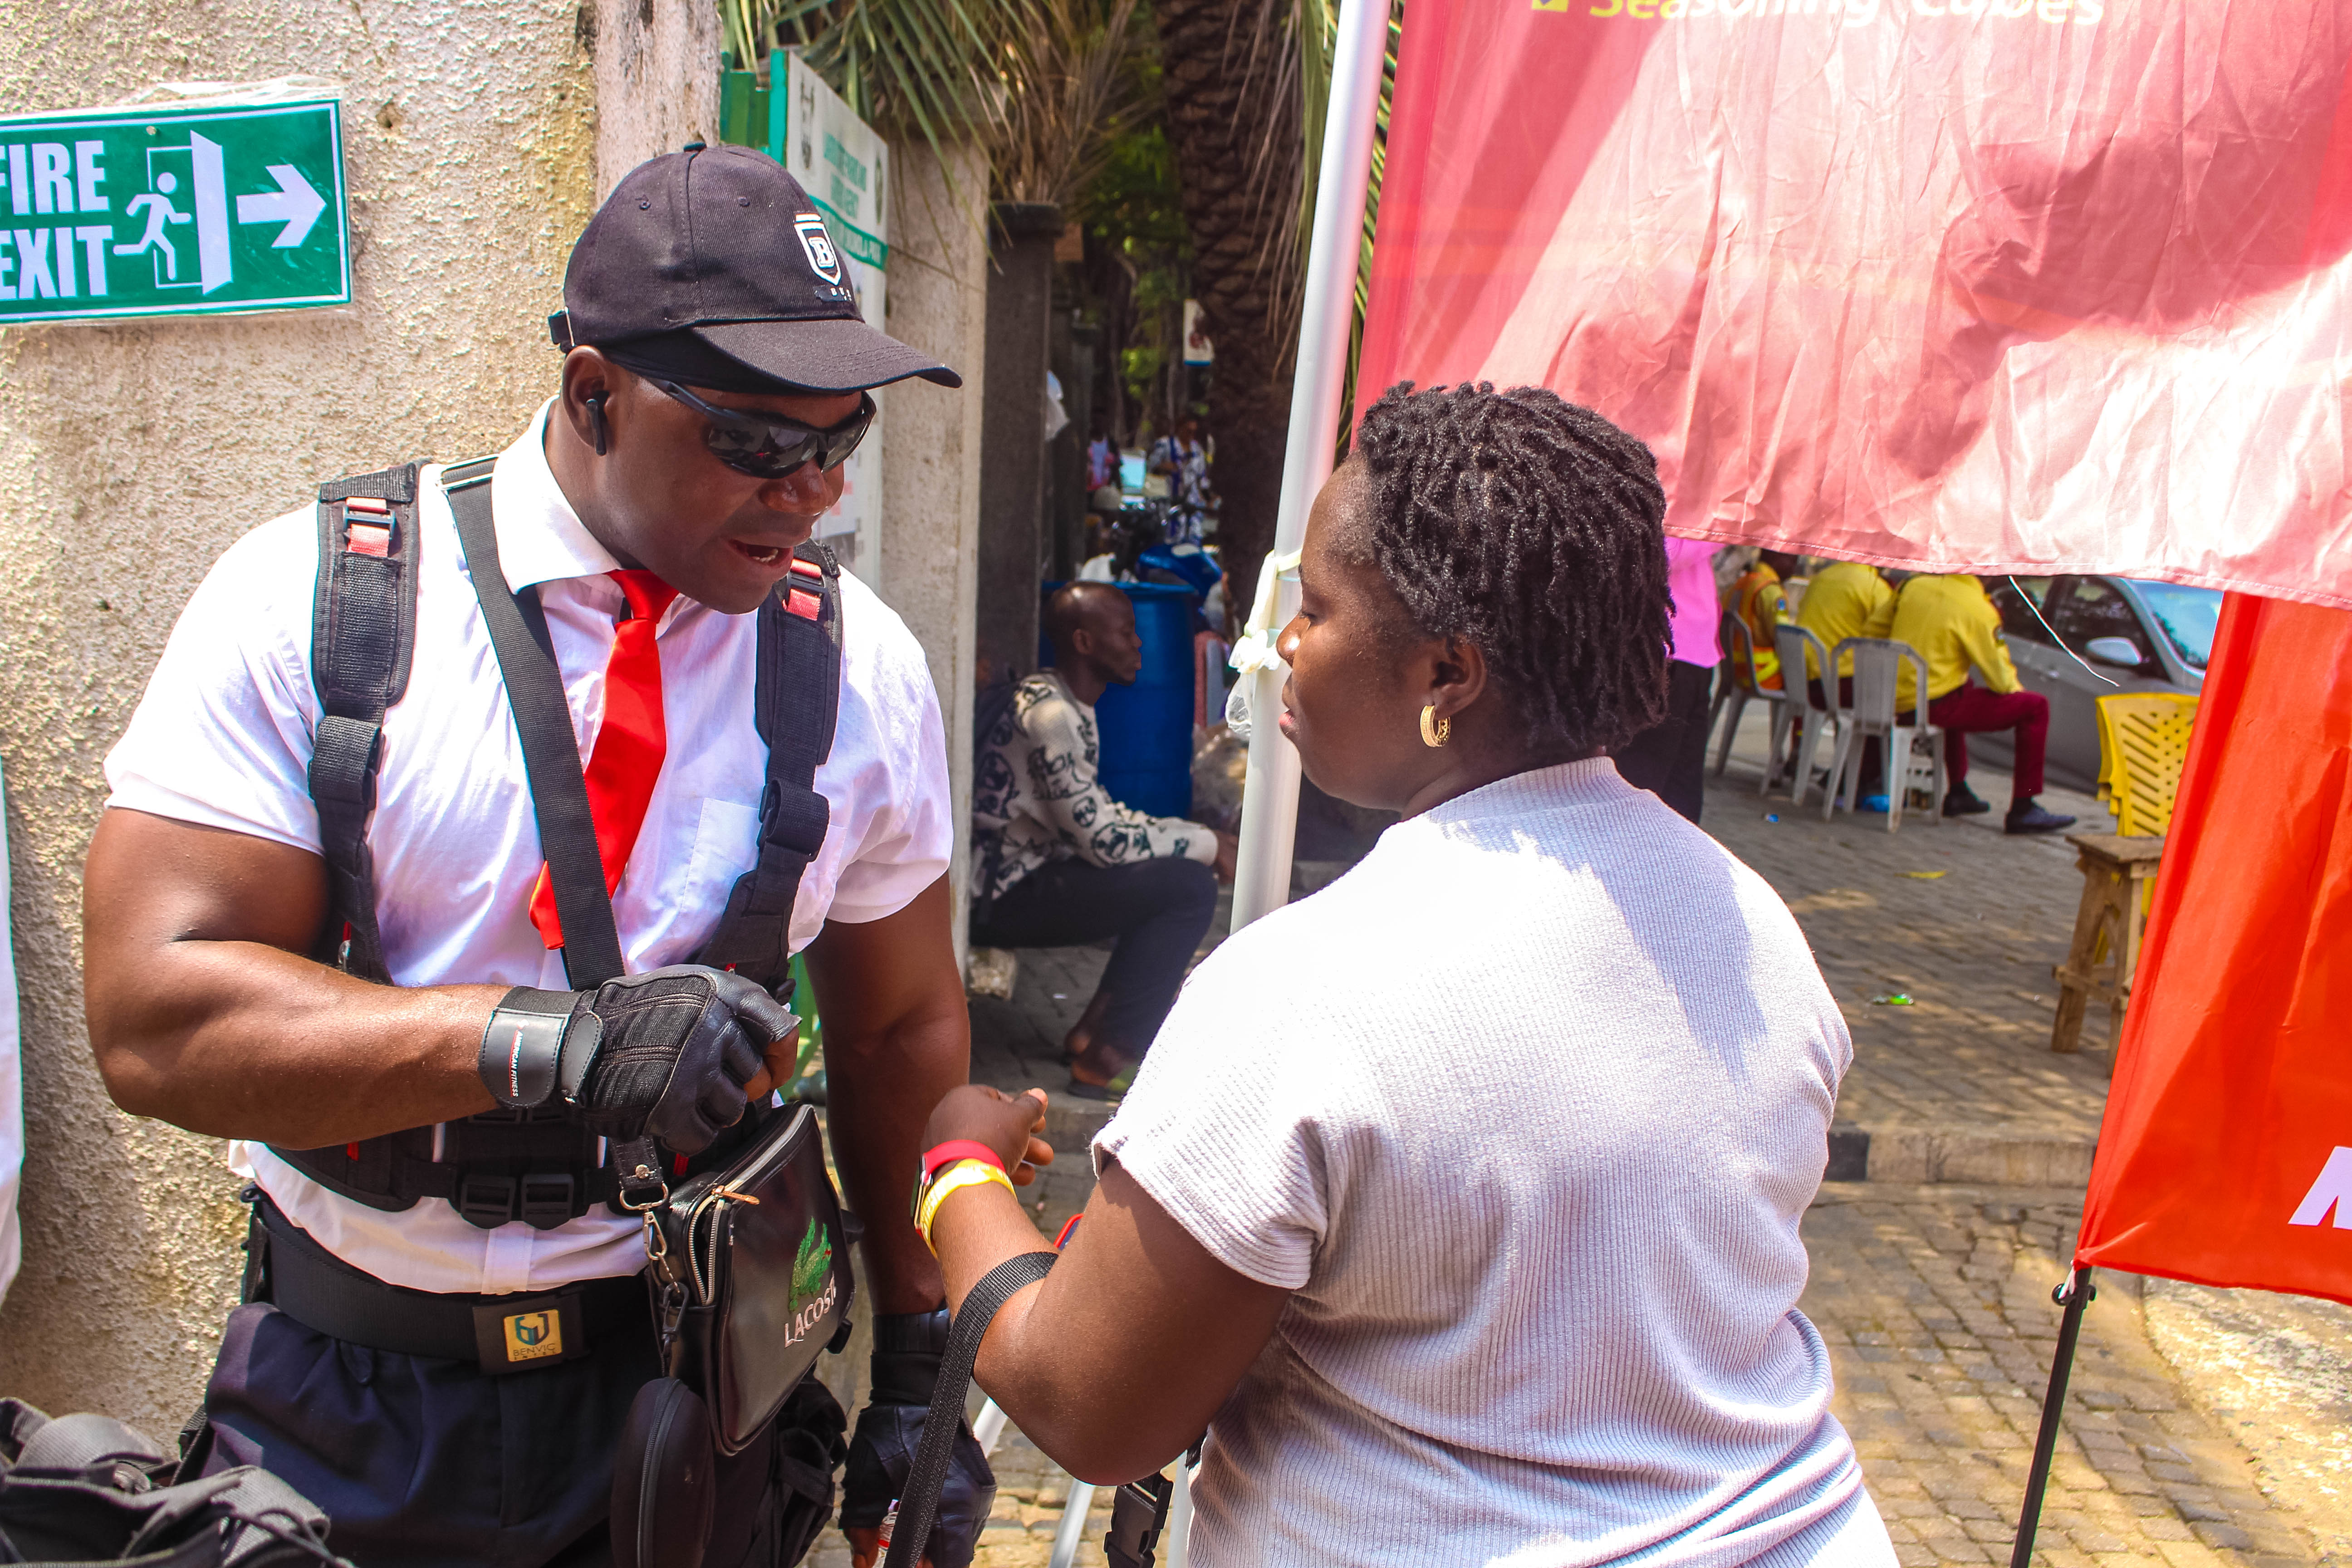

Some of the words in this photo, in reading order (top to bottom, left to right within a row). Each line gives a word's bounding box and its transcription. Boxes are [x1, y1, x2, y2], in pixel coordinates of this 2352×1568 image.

[0, 140, 110, 215] IRE
[510, 1031, 524, 1069] AMERICAN
[784, 1270, 836, 1348] LACOST
